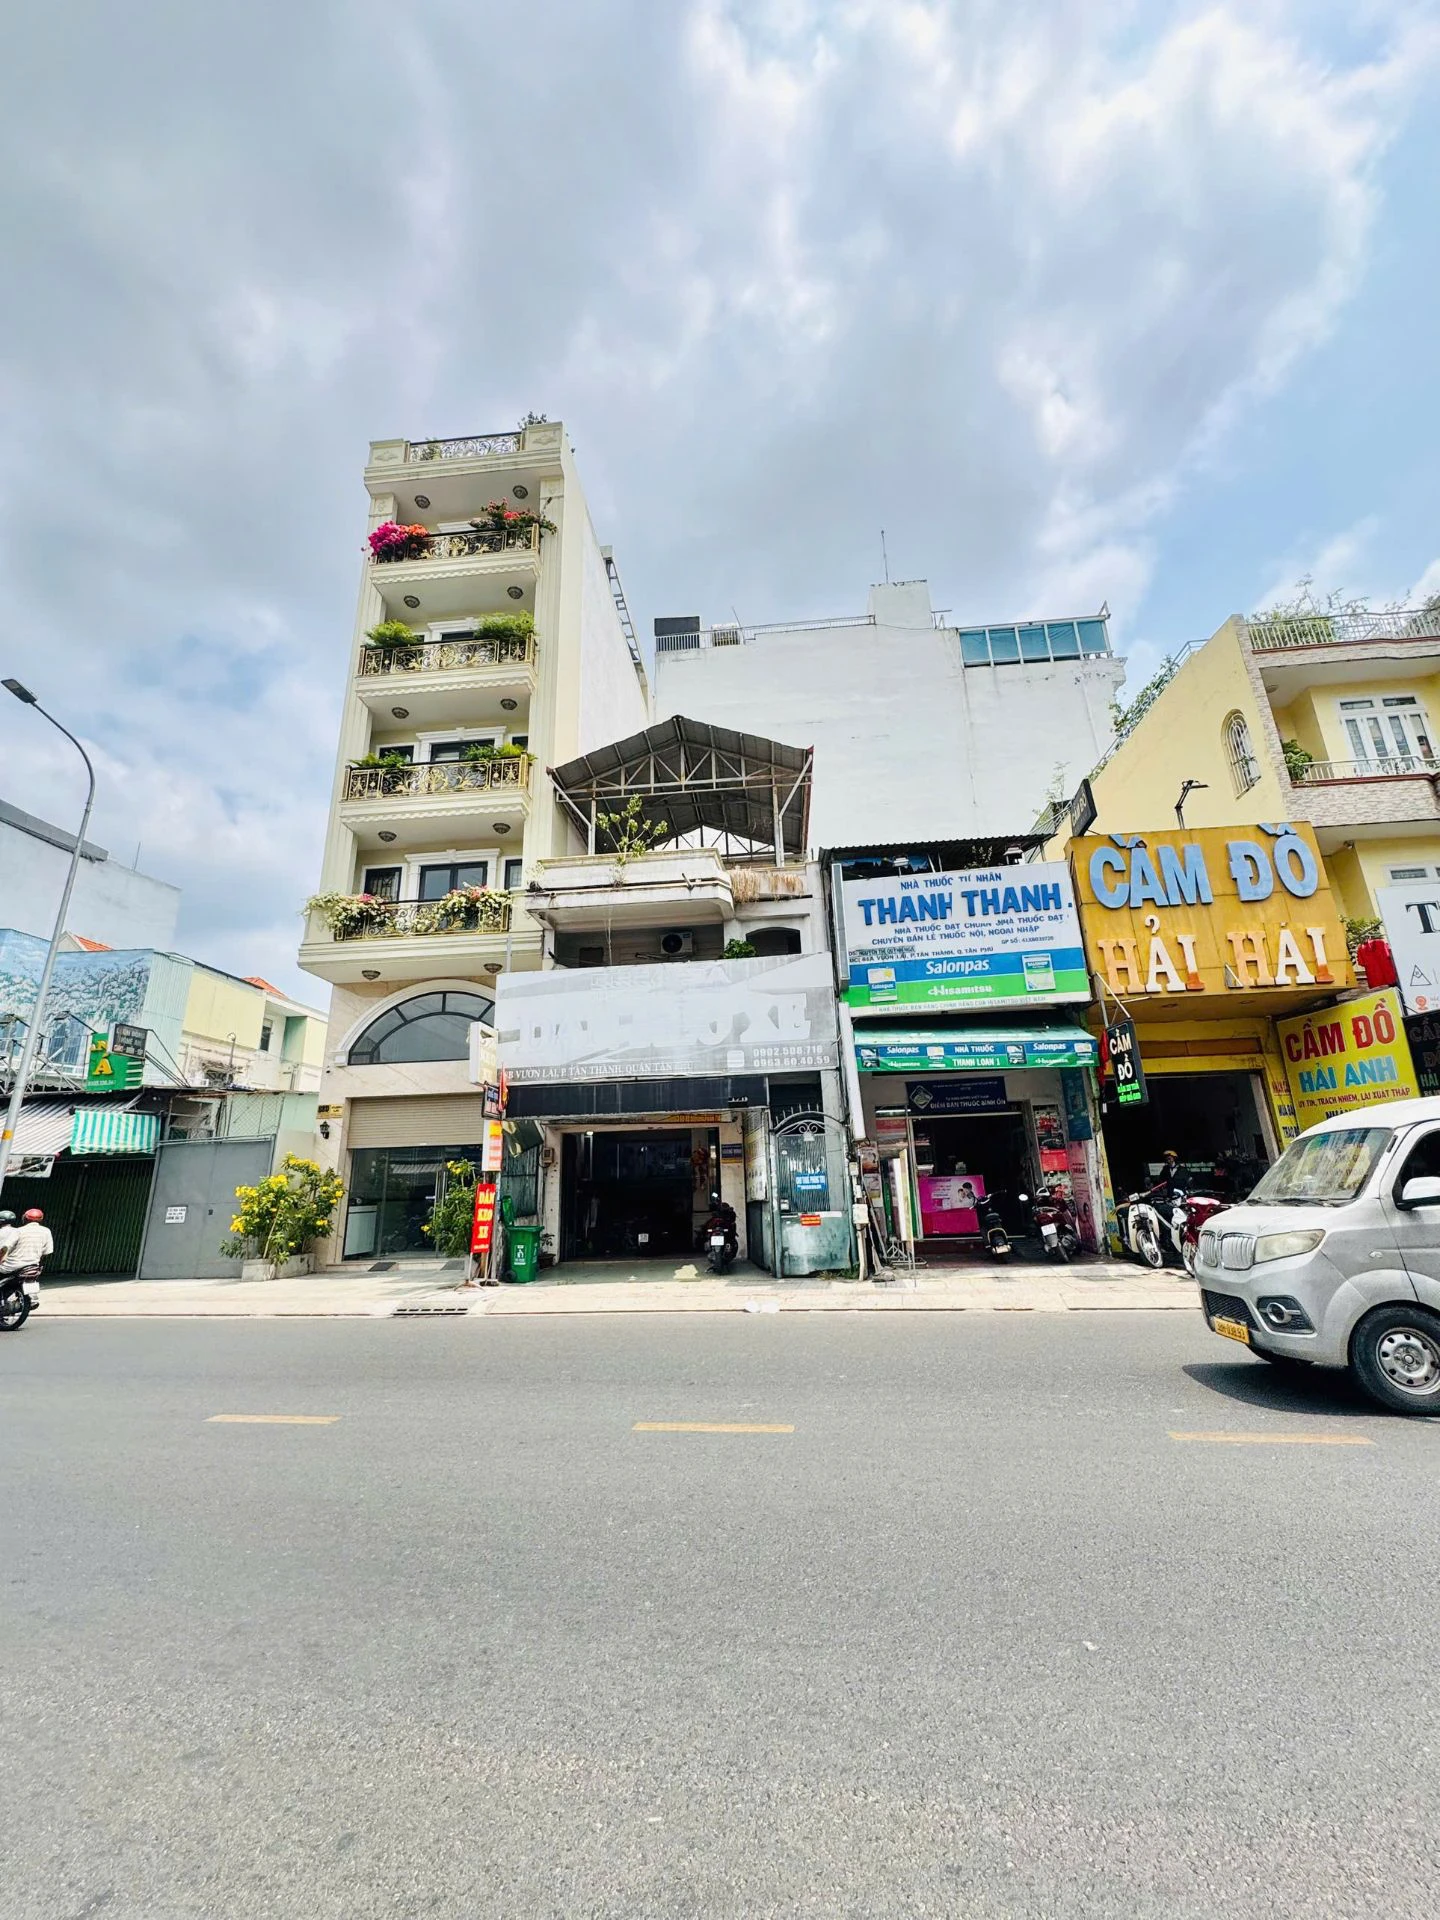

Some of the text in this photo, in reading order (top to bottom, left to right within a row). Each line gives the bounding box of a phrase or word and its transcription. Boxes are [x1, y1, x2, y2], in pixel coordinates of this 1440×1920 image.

[900, 879, 919, 890] NHÀ
[925, 876, 953, 888] THUỐC
[976, 872, 1002, 882] NHÂN
[1089, 822, 1319, 909] CẦM ĐỒ
[858, 892, 952, 925] THANH
[872, 936, 904, 945] CHUYÊN
[907, 934, 924, 942] BÁN
[940, 931, 966, 940] THUỐC
[926, 959, 990, 975] Salonpas
[1097, 915, 1205, 995] HẢI
[1285, 998, 1396, 1063] CẦM ĐỒ
[955, 1044, 969, 1053] NHÀ
[971, 1042, 994, 1053] THUỐC
[1298, 1063, 1338, 1093] HẢI
[1345, 1055, 1398, 1087] ANH
